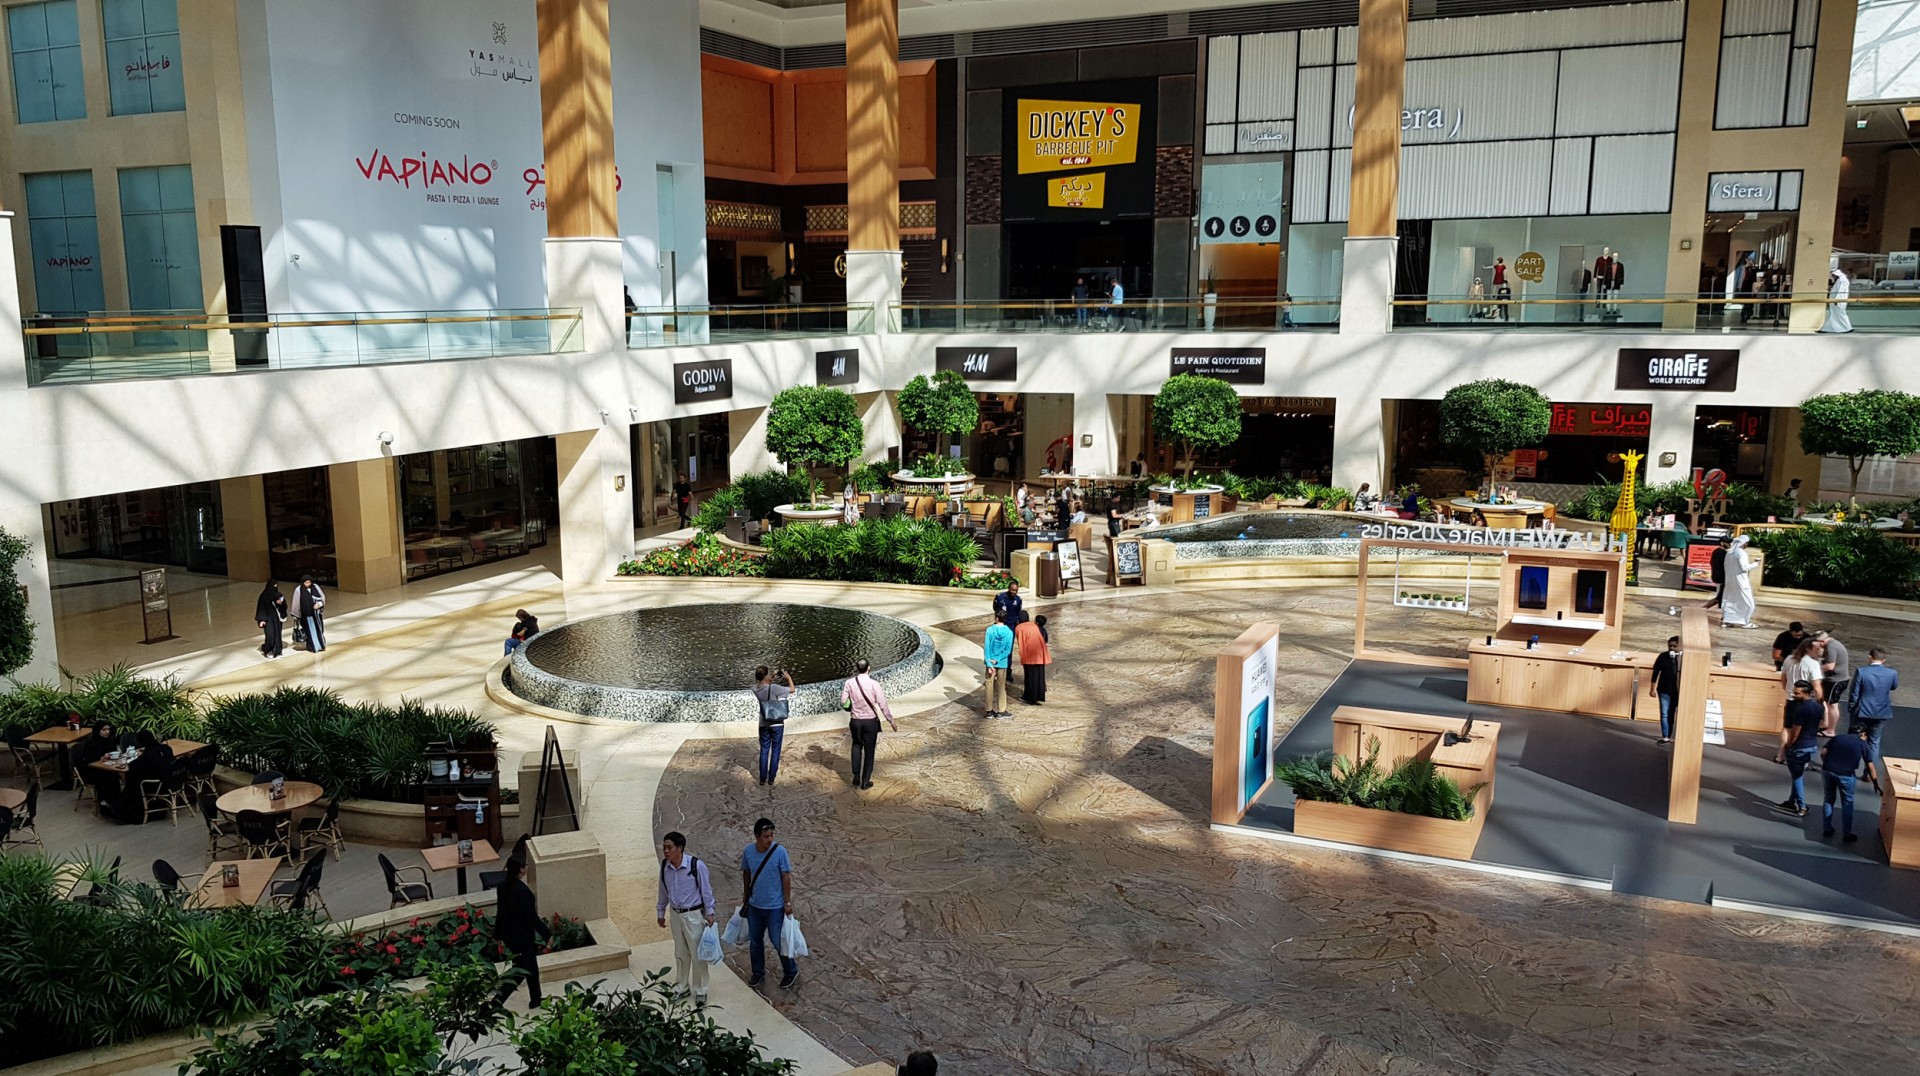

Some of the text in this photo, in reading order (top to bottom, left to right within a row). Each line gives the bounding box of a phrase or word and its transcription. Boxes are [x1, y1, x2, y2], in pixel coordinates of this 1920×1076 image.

[393, 112, 460, 130] COMING SOON
[1035, 140, 1119, 155] BARBECUE PIT
[426, 194, 500, 206] PASTA PIZZA LOUNGE
[1517, 257, 1542, 266] PART
[1517, 267, 1541, 276] SALE
[963, 353, 989, 373] H&M
[1174, 356, 1262, 366] LE PAIN QUOTIDIEN
[1648, 353, 1709, 377] GIRAFFE
[682, 367, 726, 386] GODIVA
[1674, 377, 1706, 385] KITCHEN
